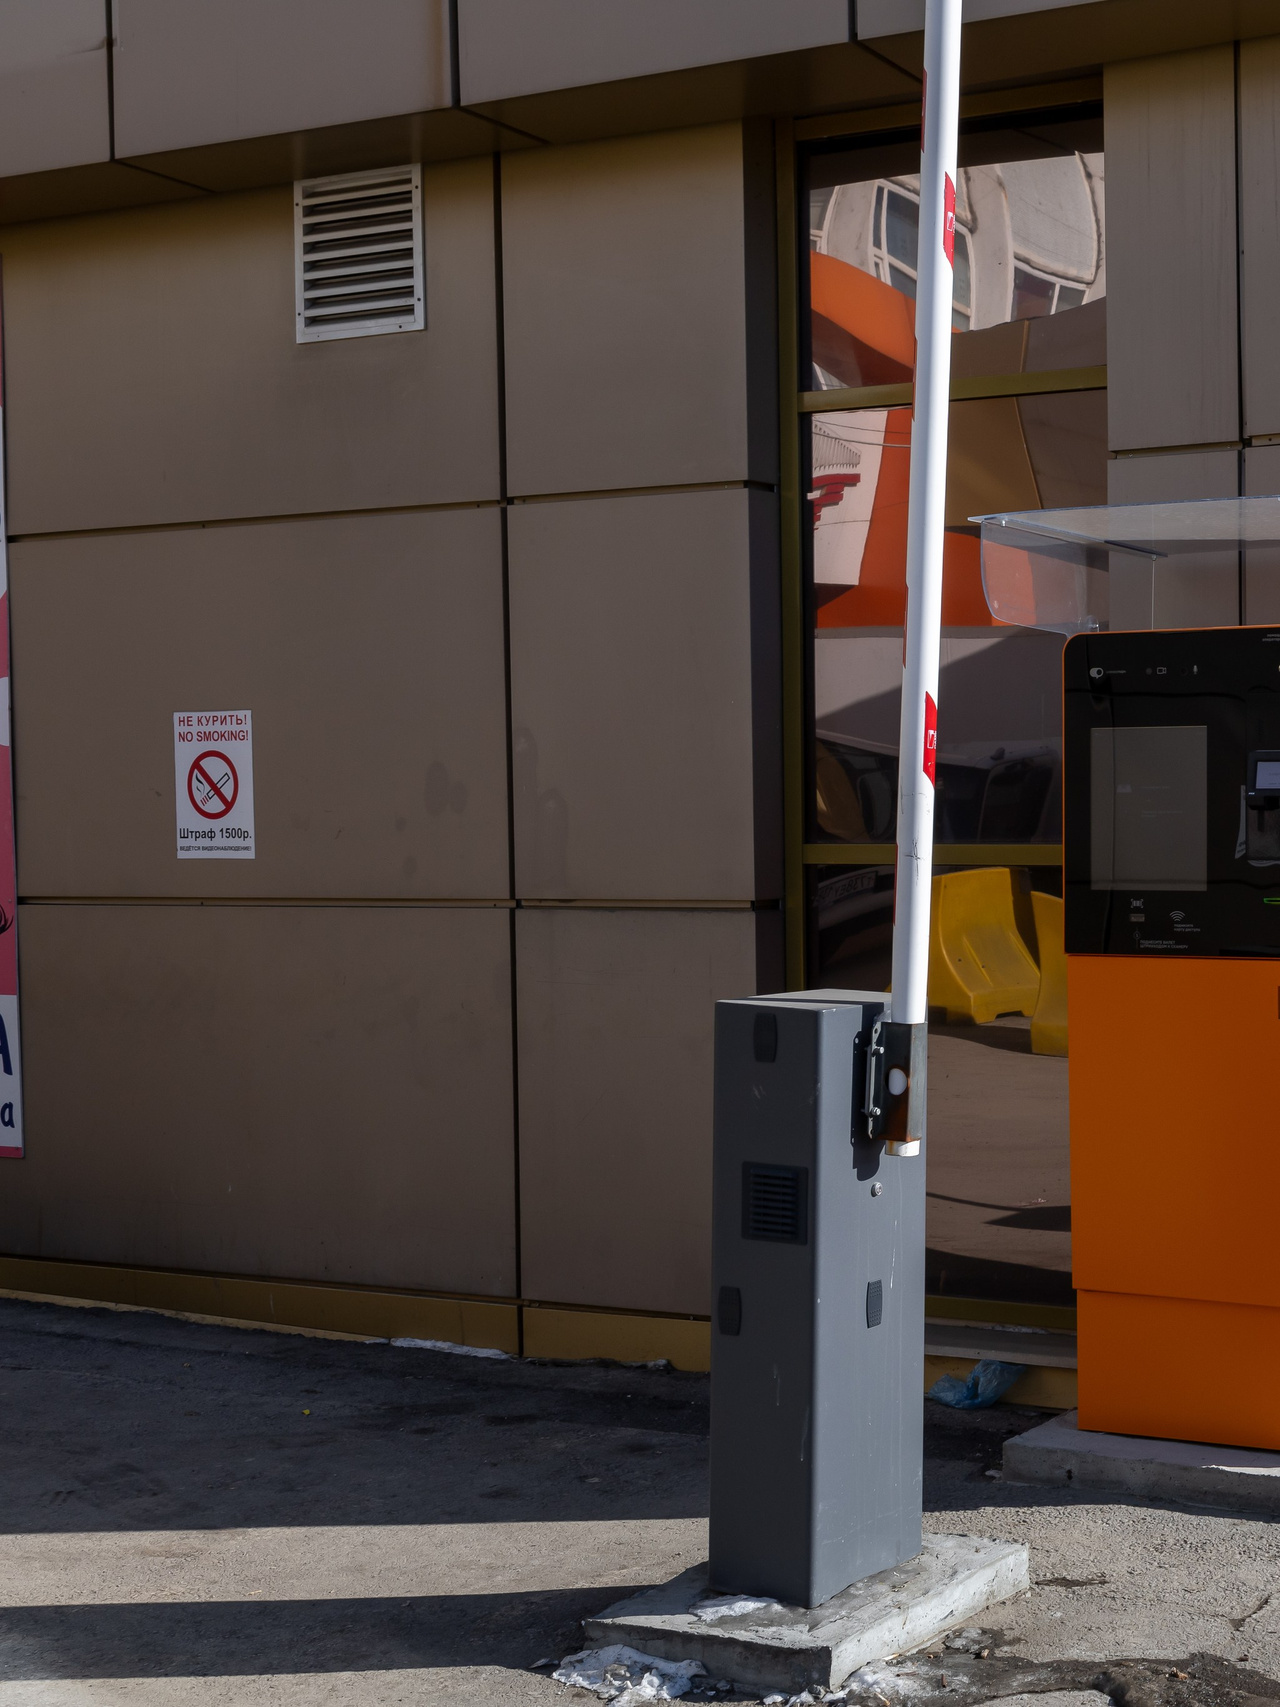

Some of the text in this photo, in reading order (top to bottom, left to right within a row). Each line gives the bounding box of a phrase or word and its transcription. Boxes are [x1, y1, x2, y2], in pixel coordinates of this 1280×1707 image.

[178, 714, 247, 727] НЕ КУРИТЬ!
[178, 730, 249, 743] NO SMOKING!
[179, 827, 252, 842] Штраф 1500р.
